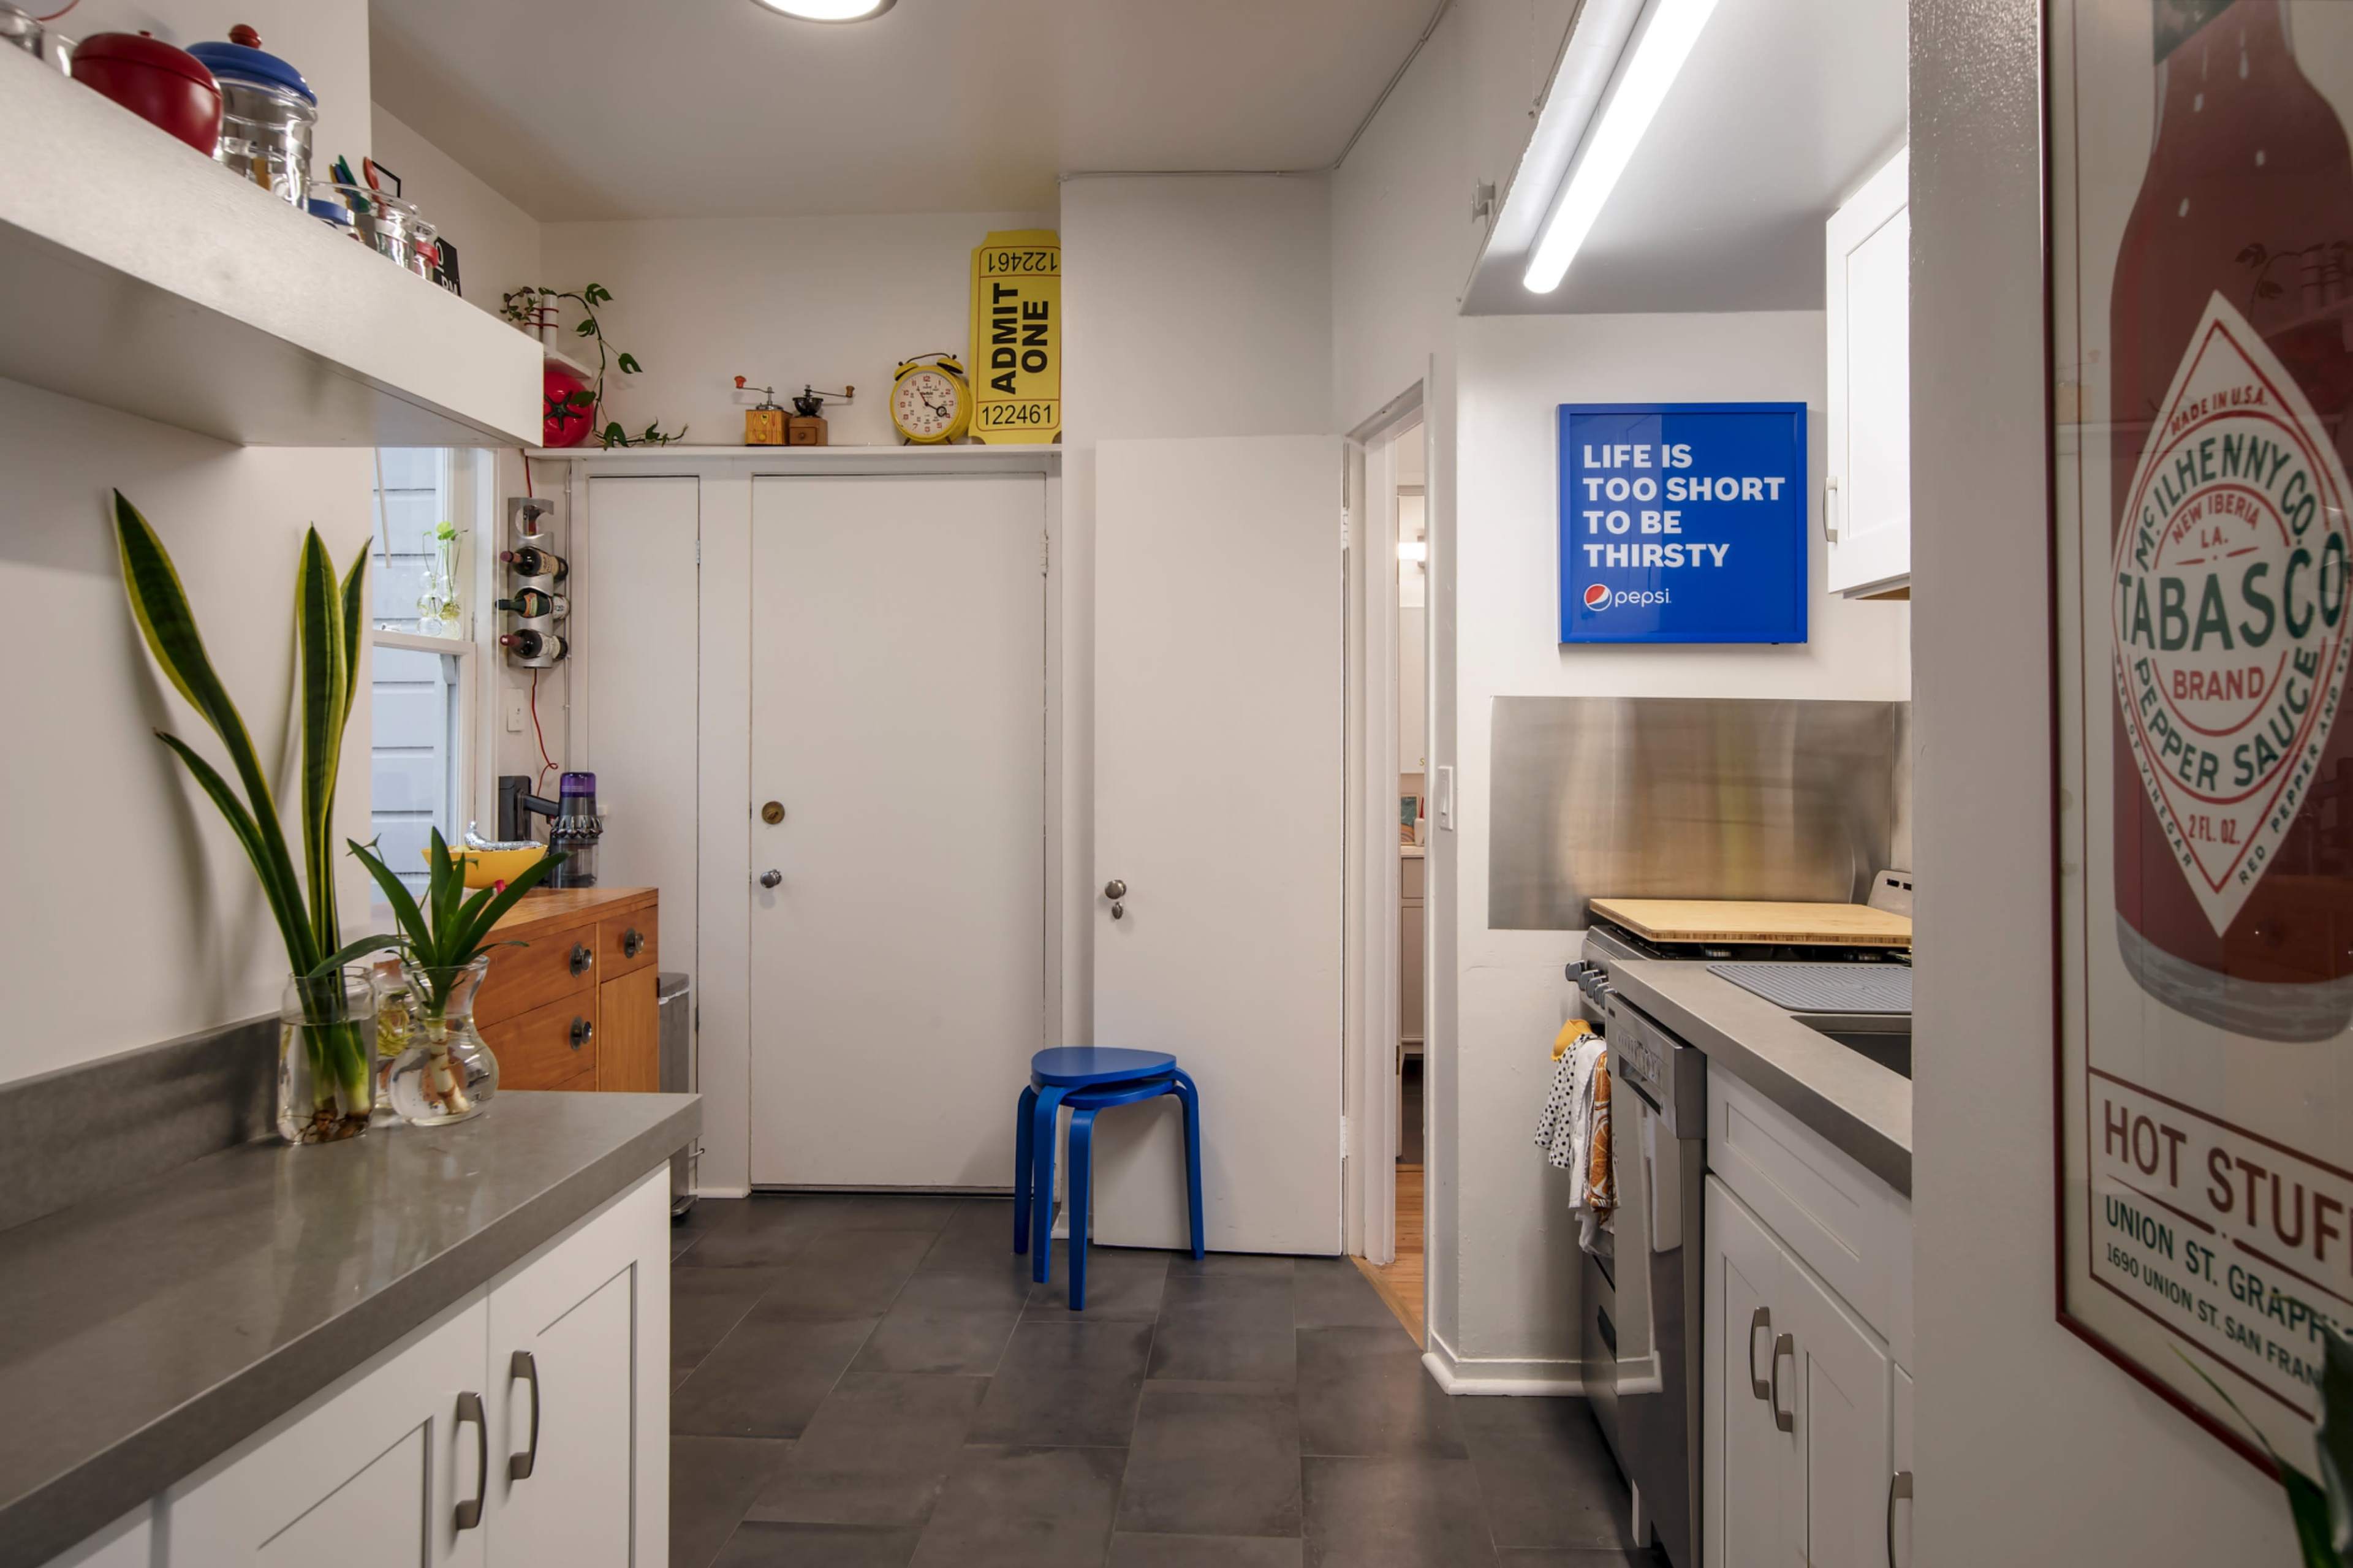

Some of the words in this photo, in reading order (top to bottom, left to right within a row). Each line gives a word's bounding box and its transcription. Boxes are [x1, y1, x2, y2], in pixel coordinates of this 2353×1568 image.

[988, 252, 1058, 273] 122461
[991, 282, 1018, 395] ADMIT
[1021, 301, 1048, 373] ONE
[982, 404, 1051, 425] 122461
[2170, 398, 2208, 435] MADE
[2213, 390, 2227, 410] IN
[2231, 385, 2267, 406] U.S.A.
[1584, 444, 1652, 468] LIFE
[1662, 444, 1692, 468] IS
[1583, 477, 1658, 501] TOO
[1666, 477, 1786, 501] SHORT
[1583, 510, 1631, 534] TO
[1641, 510, 1682, 534] BE
[2172, 502, 2202, 544] NEW
[2208, 493, 2260, 530] IBERIA
[2201, 526, 2229, 548] LA.
[1583, 543, 1730, 567] THIRSTY
[1615, 588, 1670, 607] pepsi
[2119, 531, 2344, 651] TABASCO
[2173, 667, 2265, 700] BRAND
[2135, 657, 2219, 792] PEPPER
[2234, 646, 2319, 787] SAUCE
[2141, 761, 2192, 867] VINEGAR
[2189, 814, 2196, 838] 2
[2199, 816, 2216, 841] FL.
[2221, 819, 2240, 844] OZ.
[2238, 846, 2266, 884] RED
[2270, 743, 2319, 833] PEPPER
[2104, 1099, 2187, 1189] HOT
[2105, 1195, 2173, 1260] UNION
[2186, 1240, 2218, 1286] ST.
[2107, 1242, 2139, 1278] 1690
[2143, 1264, 2192, 1312] UNION
[2197, 1299, 2221, 1331] ST.
[2224, 1316, 2262, 1357] SAN
